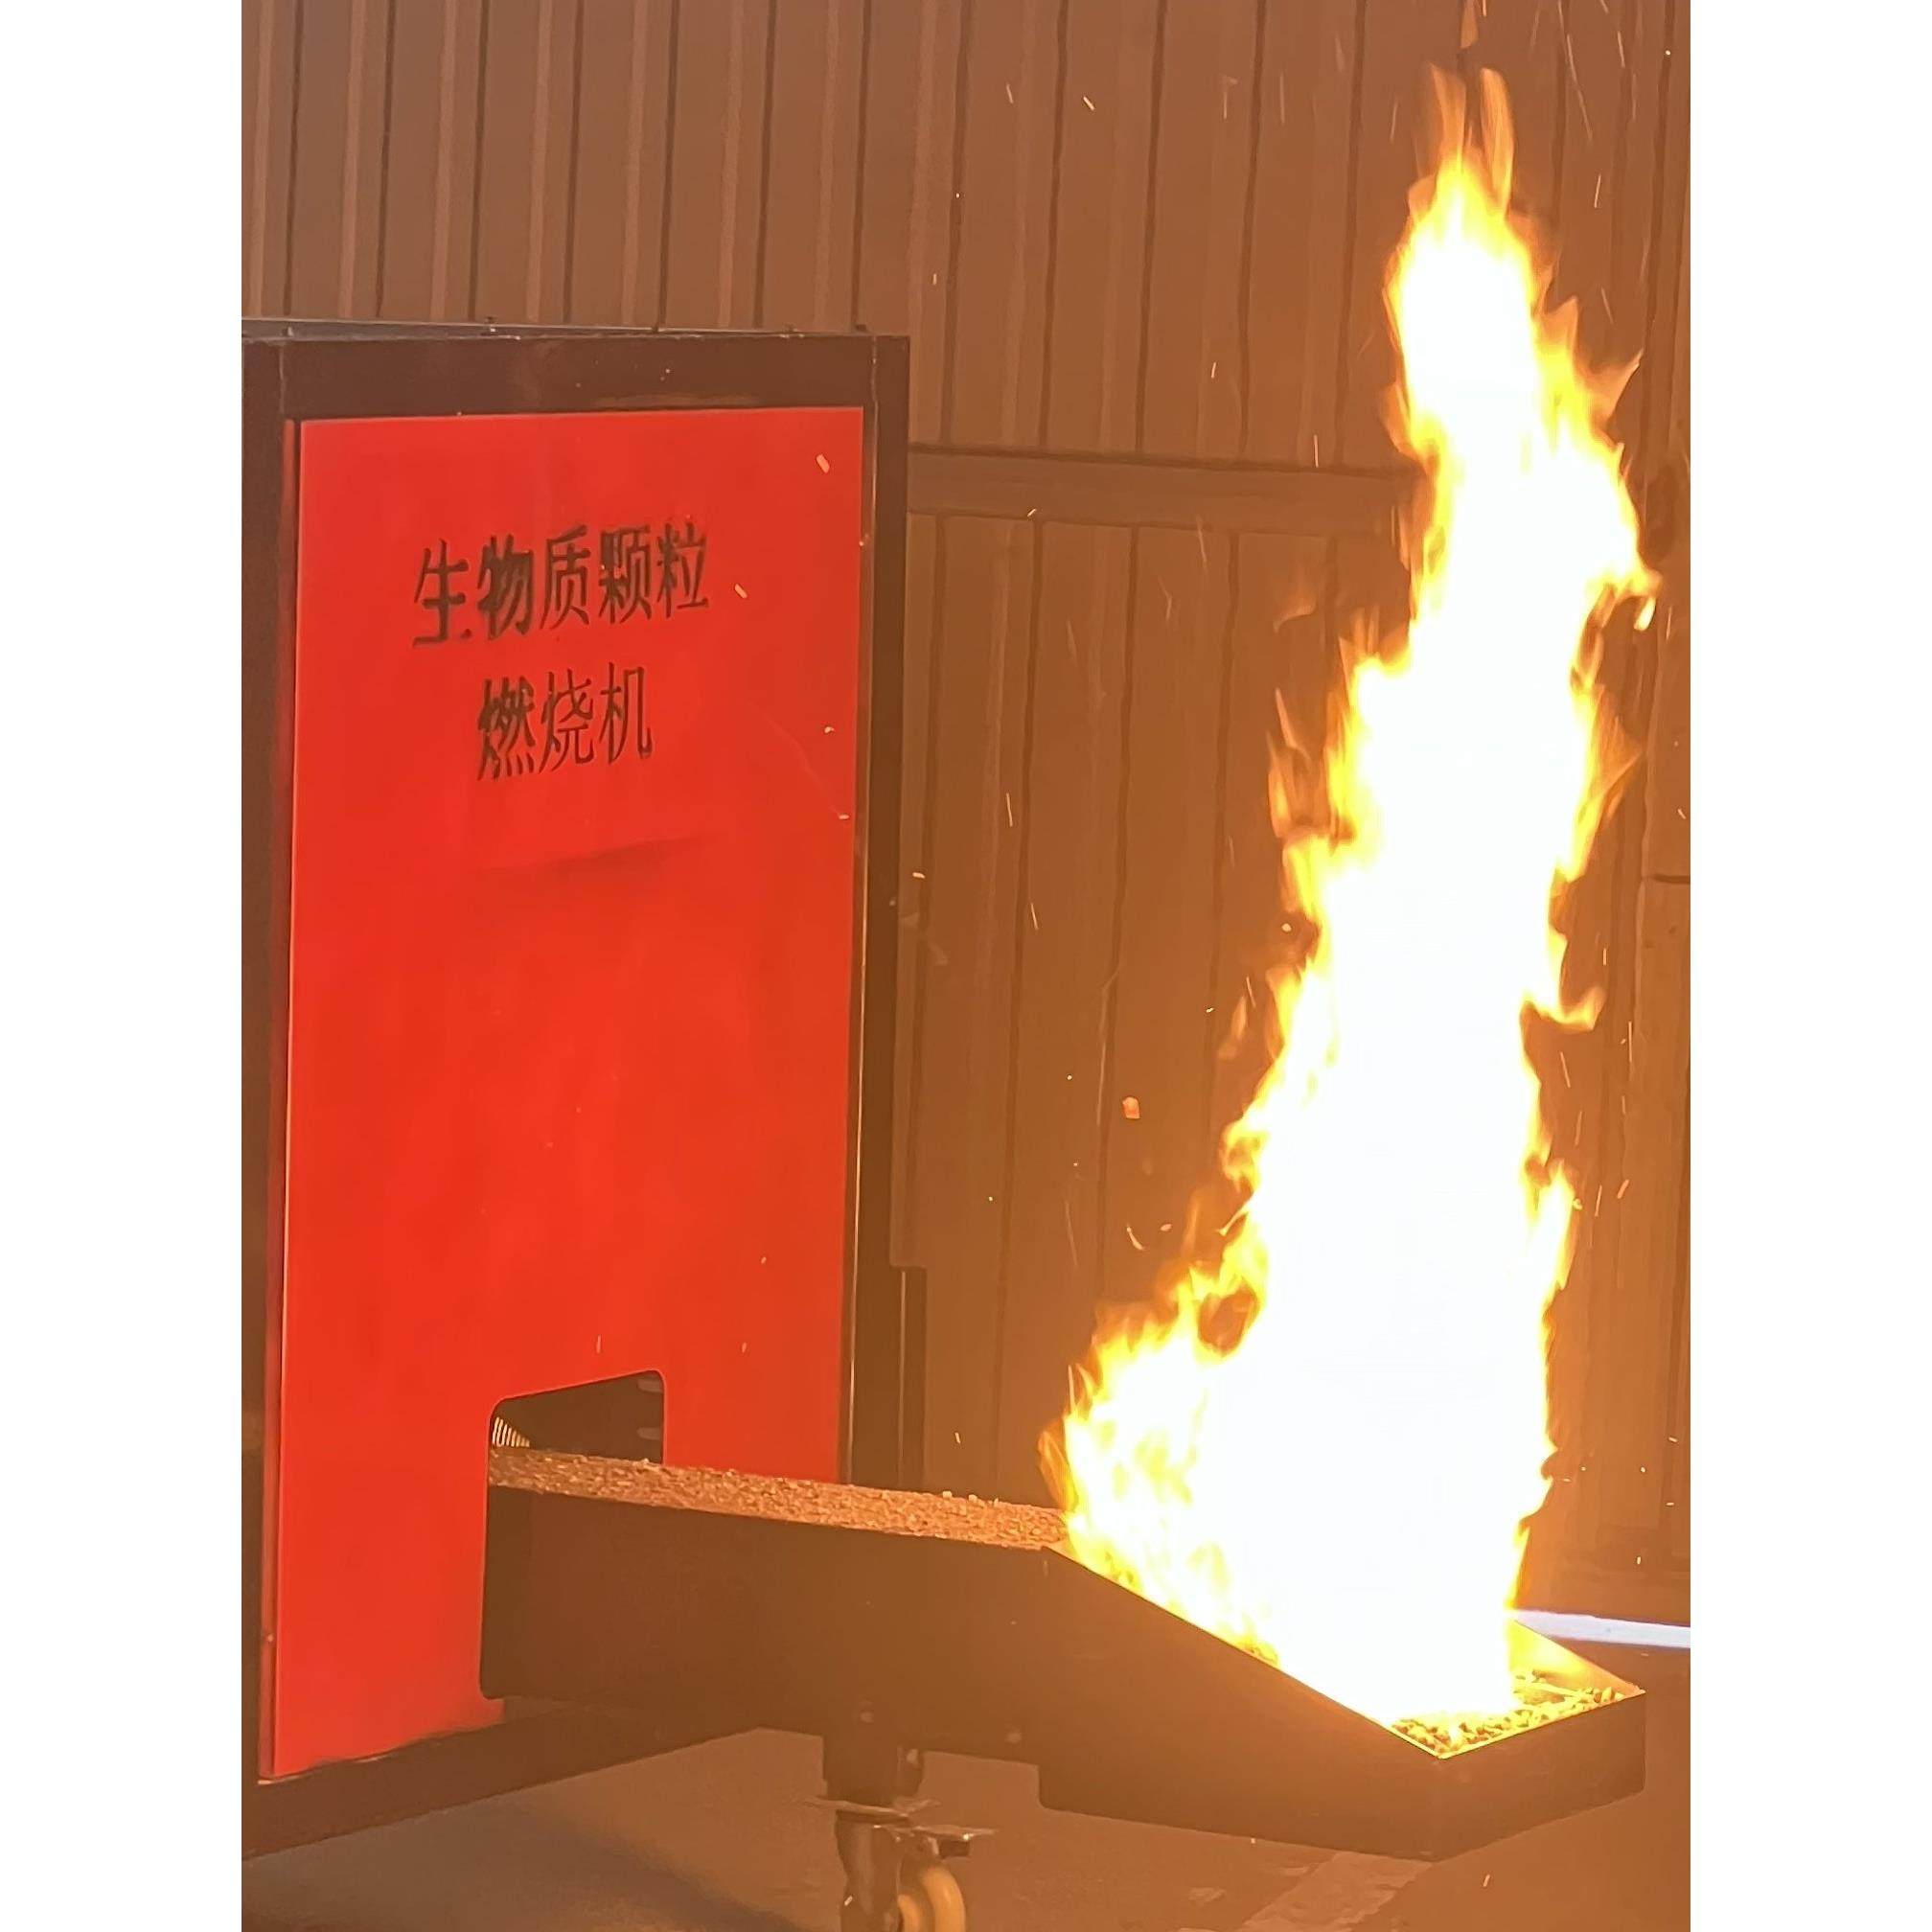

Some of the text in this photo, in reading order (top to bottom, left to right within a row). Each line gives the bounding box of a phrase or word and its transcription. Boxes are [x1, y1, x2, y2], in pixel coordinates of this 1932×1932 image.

[413, 521, 709, 647] 生物质颗粒
[477, 661, 653, 781] 燃烧机
